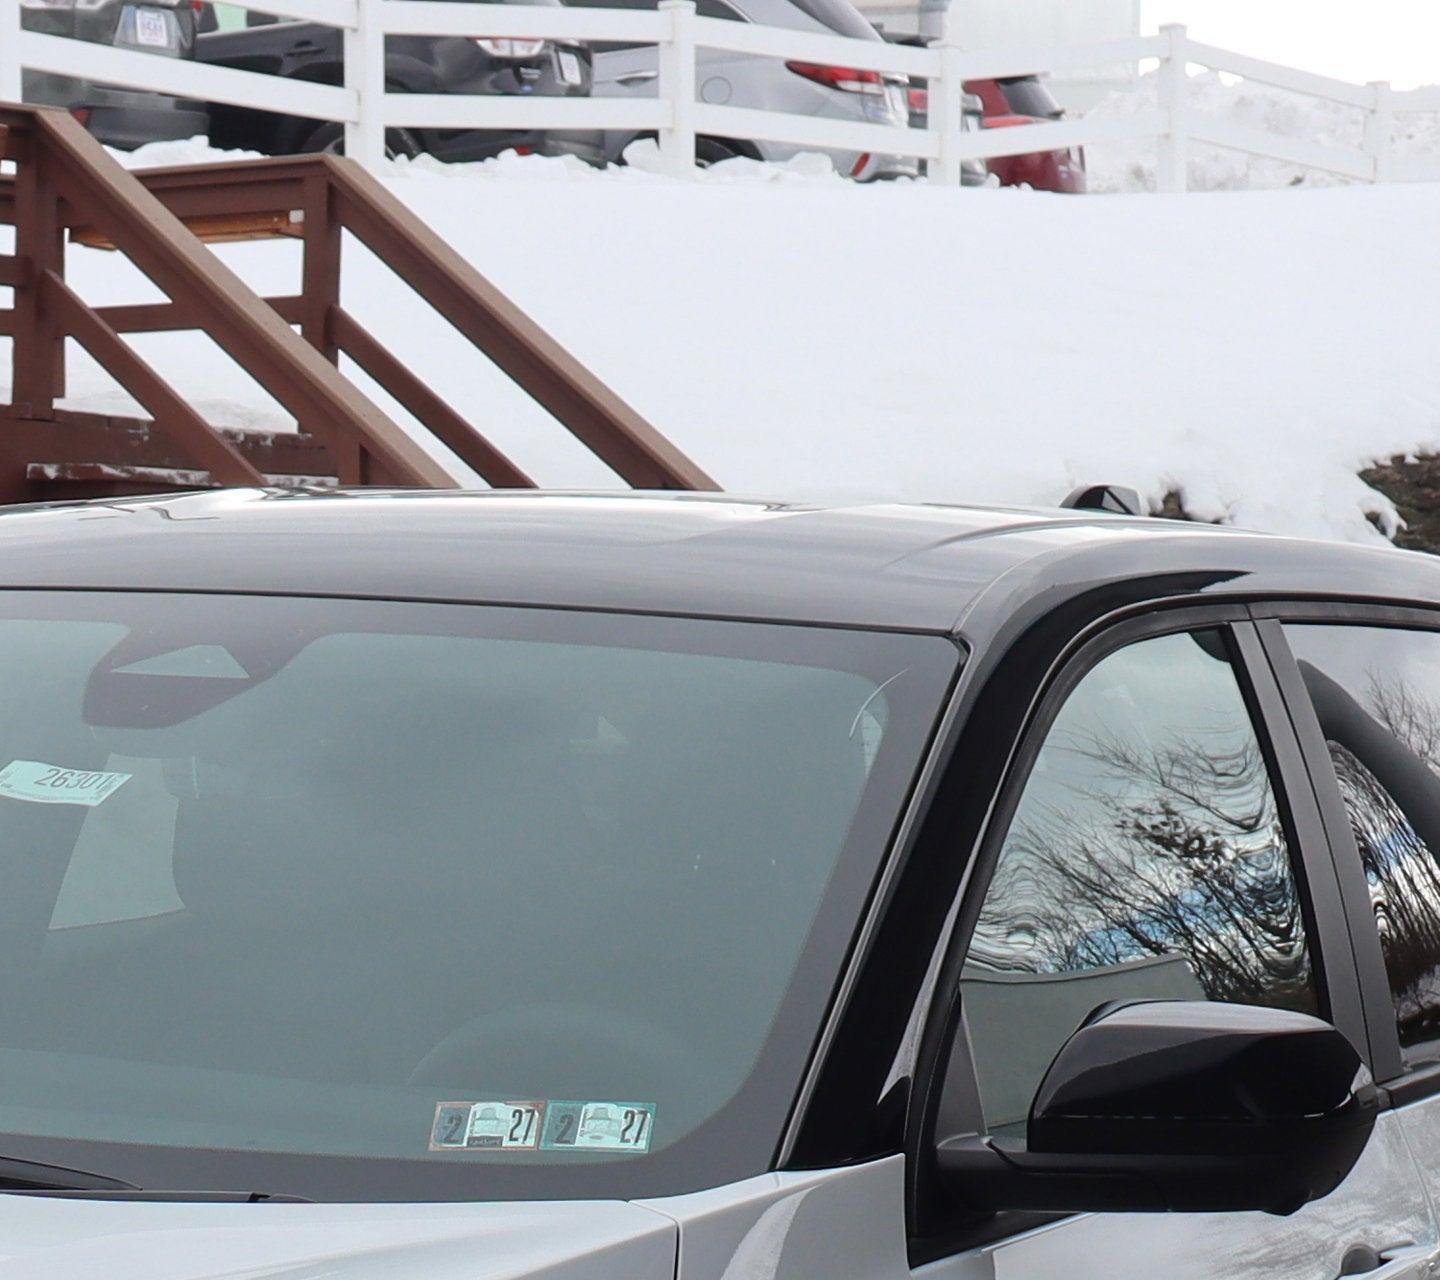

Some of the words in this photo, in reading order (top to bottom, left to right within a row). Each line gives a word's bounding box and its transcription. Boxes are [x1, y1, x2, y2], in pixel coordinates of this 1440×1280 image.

[33, 767, 115, 789] 26301
[443, 1113, 462, 1142] 2
[508, 1108, 536, 1144] 27
[555, 1113, 574, 1144] 2
[619, 1109, 649, 1145] 27
